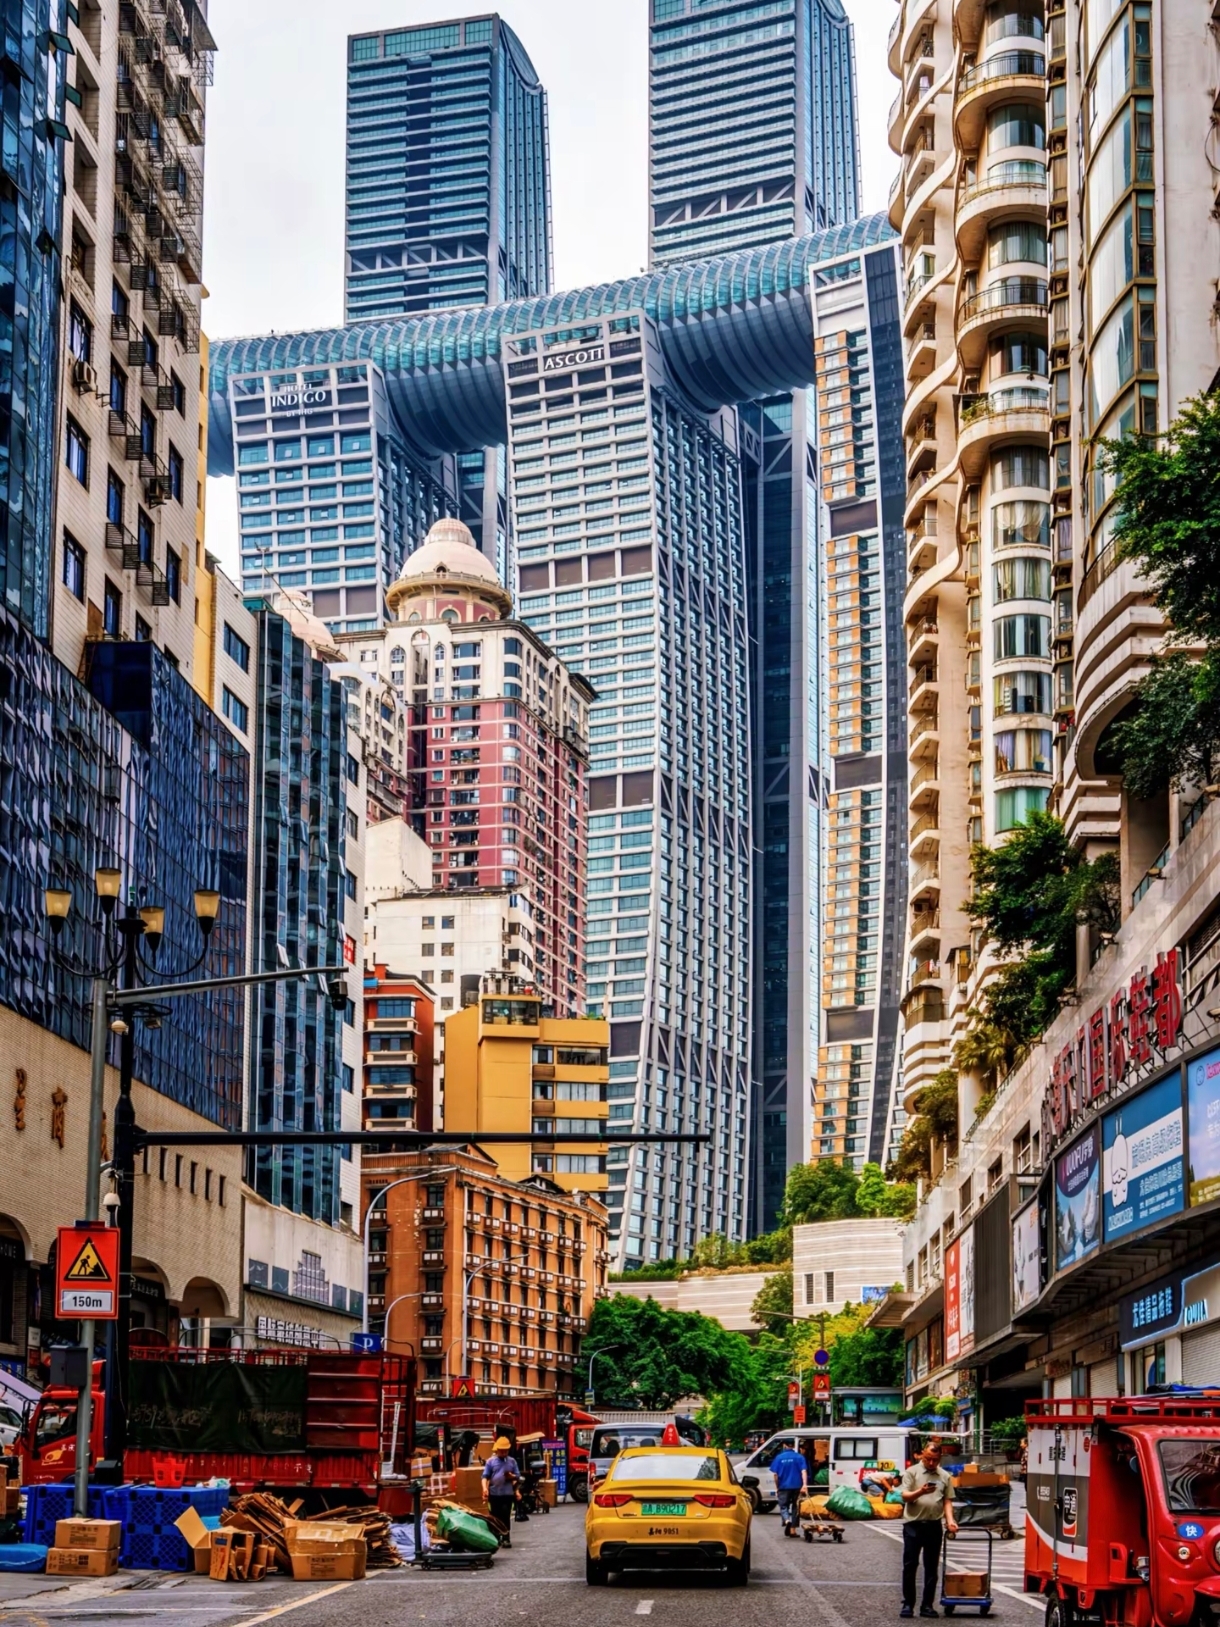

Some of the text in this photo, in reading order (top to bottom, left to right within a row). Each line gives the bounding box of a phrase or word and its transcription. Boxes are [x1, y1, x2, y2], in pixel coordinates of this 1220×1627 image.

[544, 347, 604, 370] ASCOTT
[284, 383, 312, 392] HOTEL
[272, 390, 326, 407] INDIGO
[72, 1295, 102, 1308] 150m
[1185, 1525, 1197, 1537] 快
